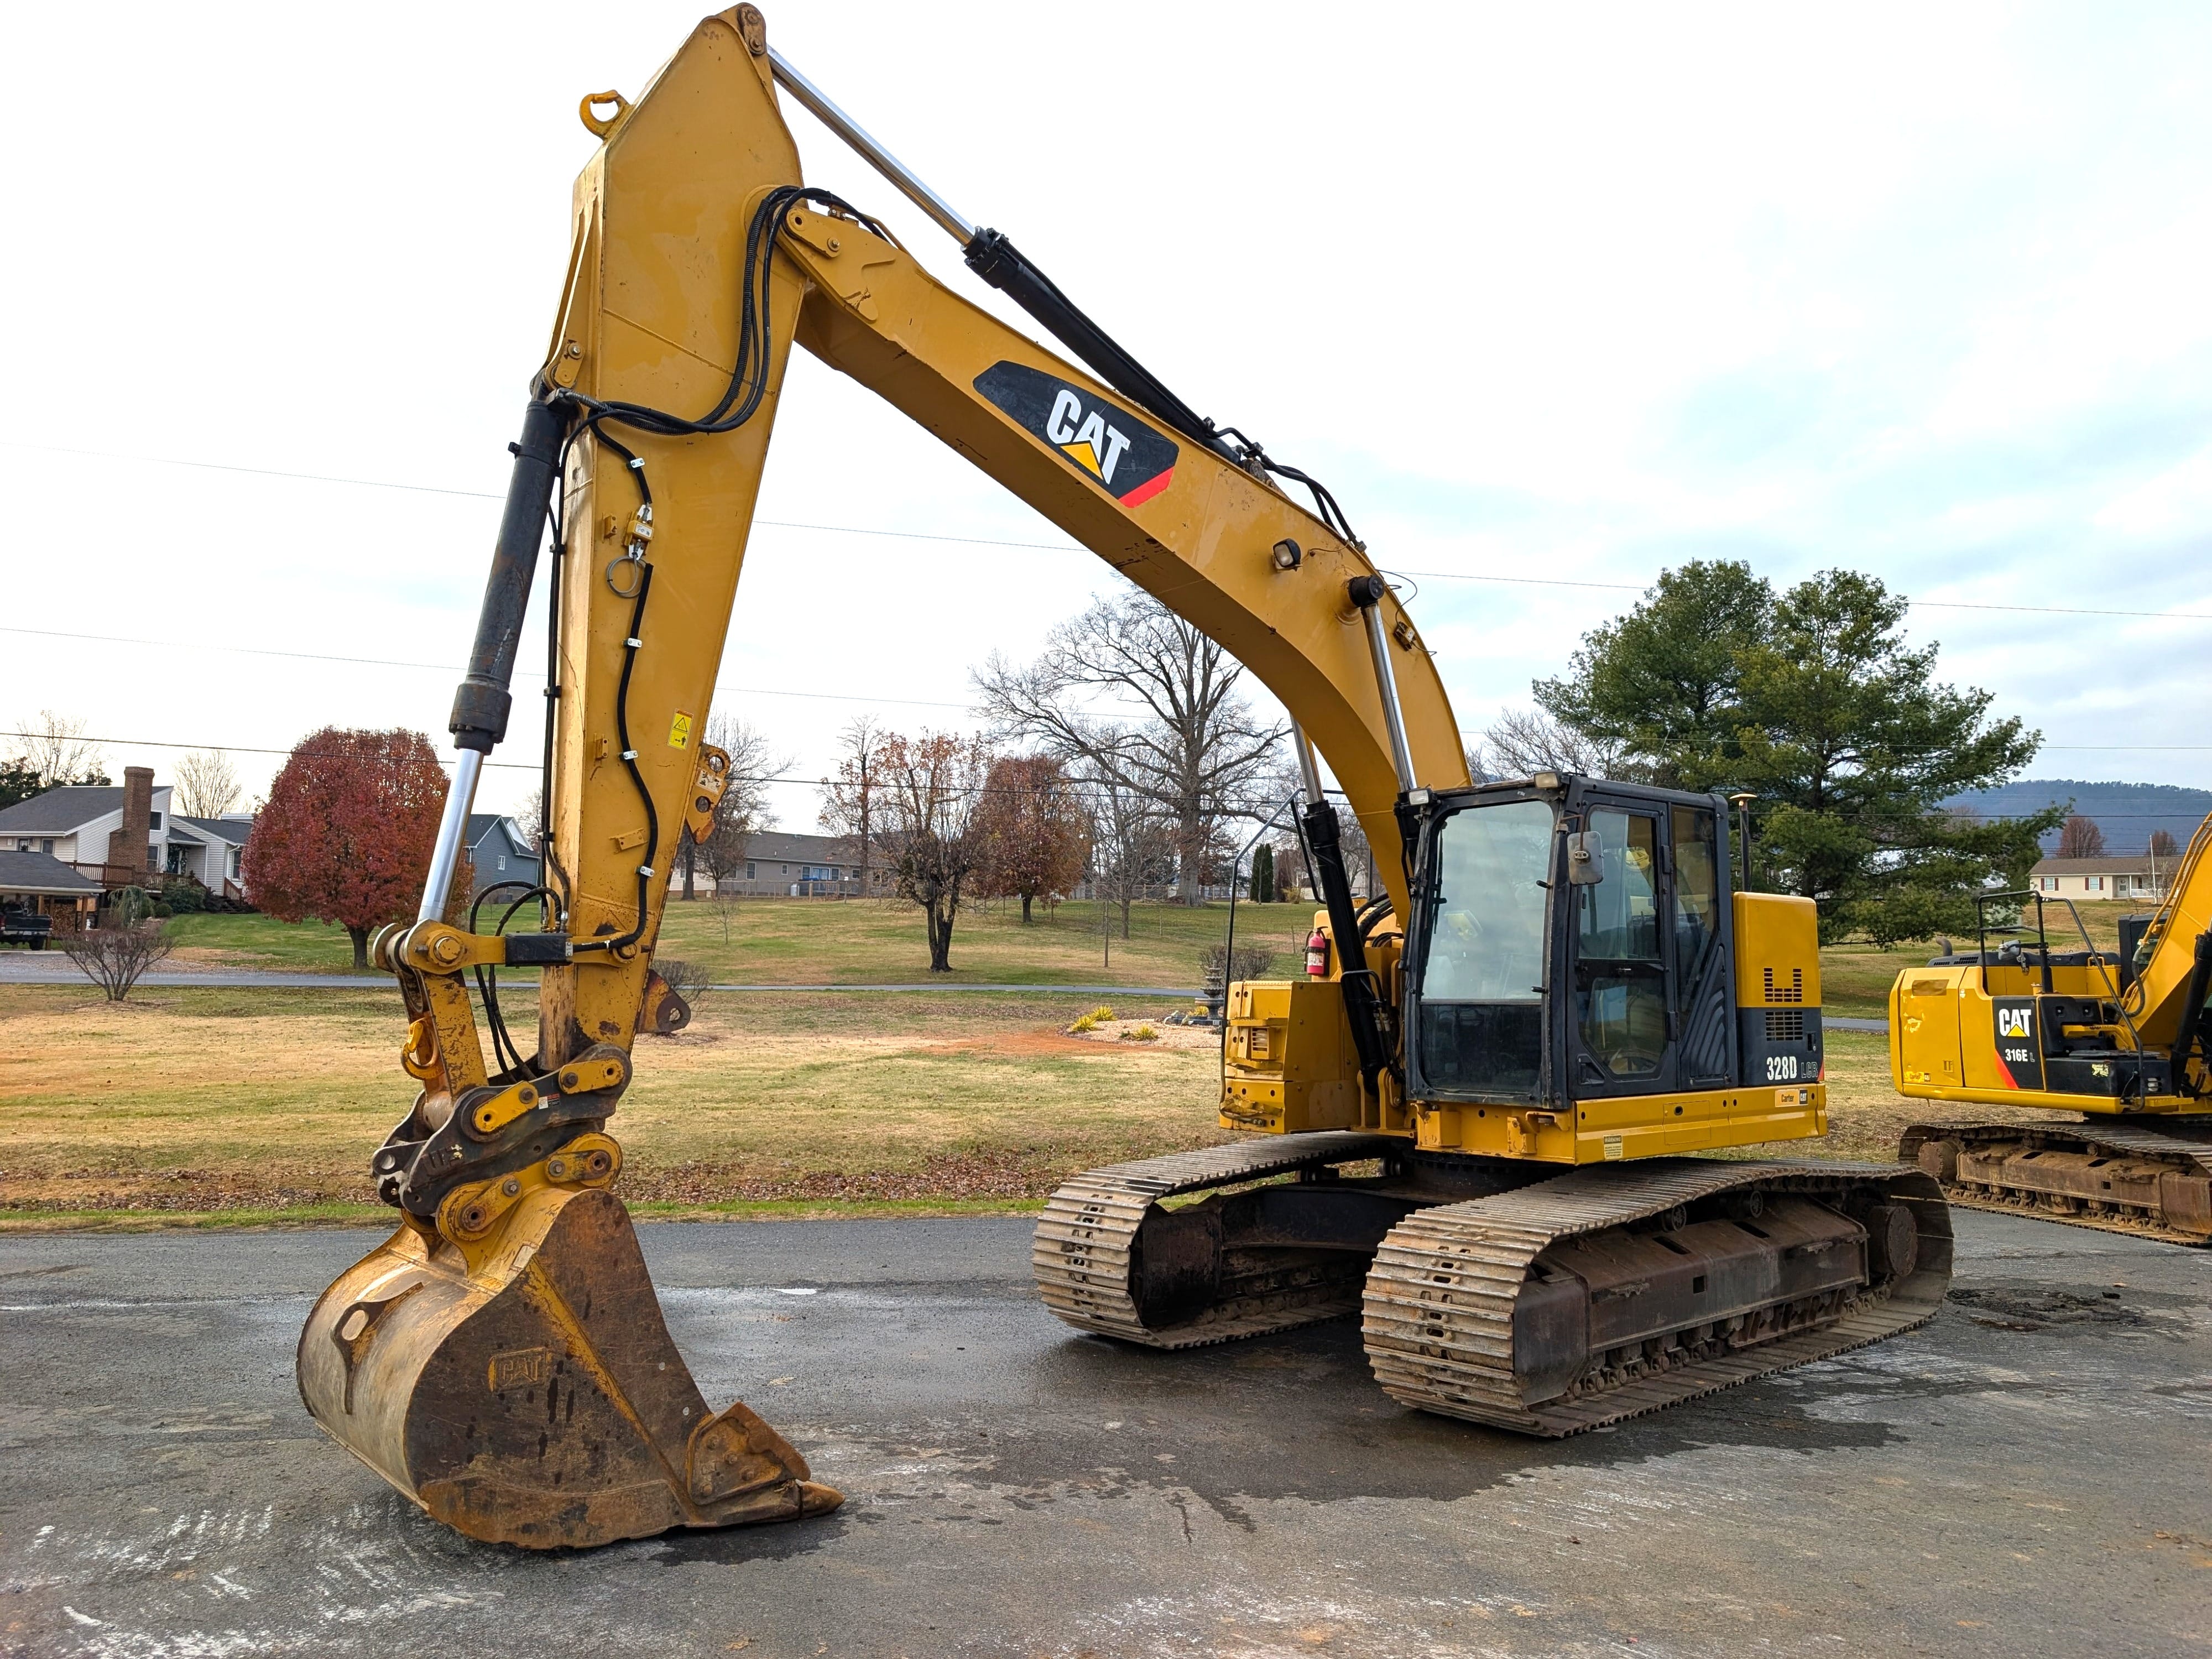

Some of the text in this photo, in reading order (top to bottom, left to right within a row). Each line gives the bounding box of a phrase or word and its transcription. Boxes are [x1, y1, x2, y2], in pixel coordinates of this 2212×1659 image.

[1047, 389, 1131, 484] CAT
[1999, 1009, 2031, 1037] CAT
[1766, 1056, 1818, 1080] 328D LCR
[2005, 1048, 2035, 1062] 316E L
[500, 1355, 541, 1386] CAT
